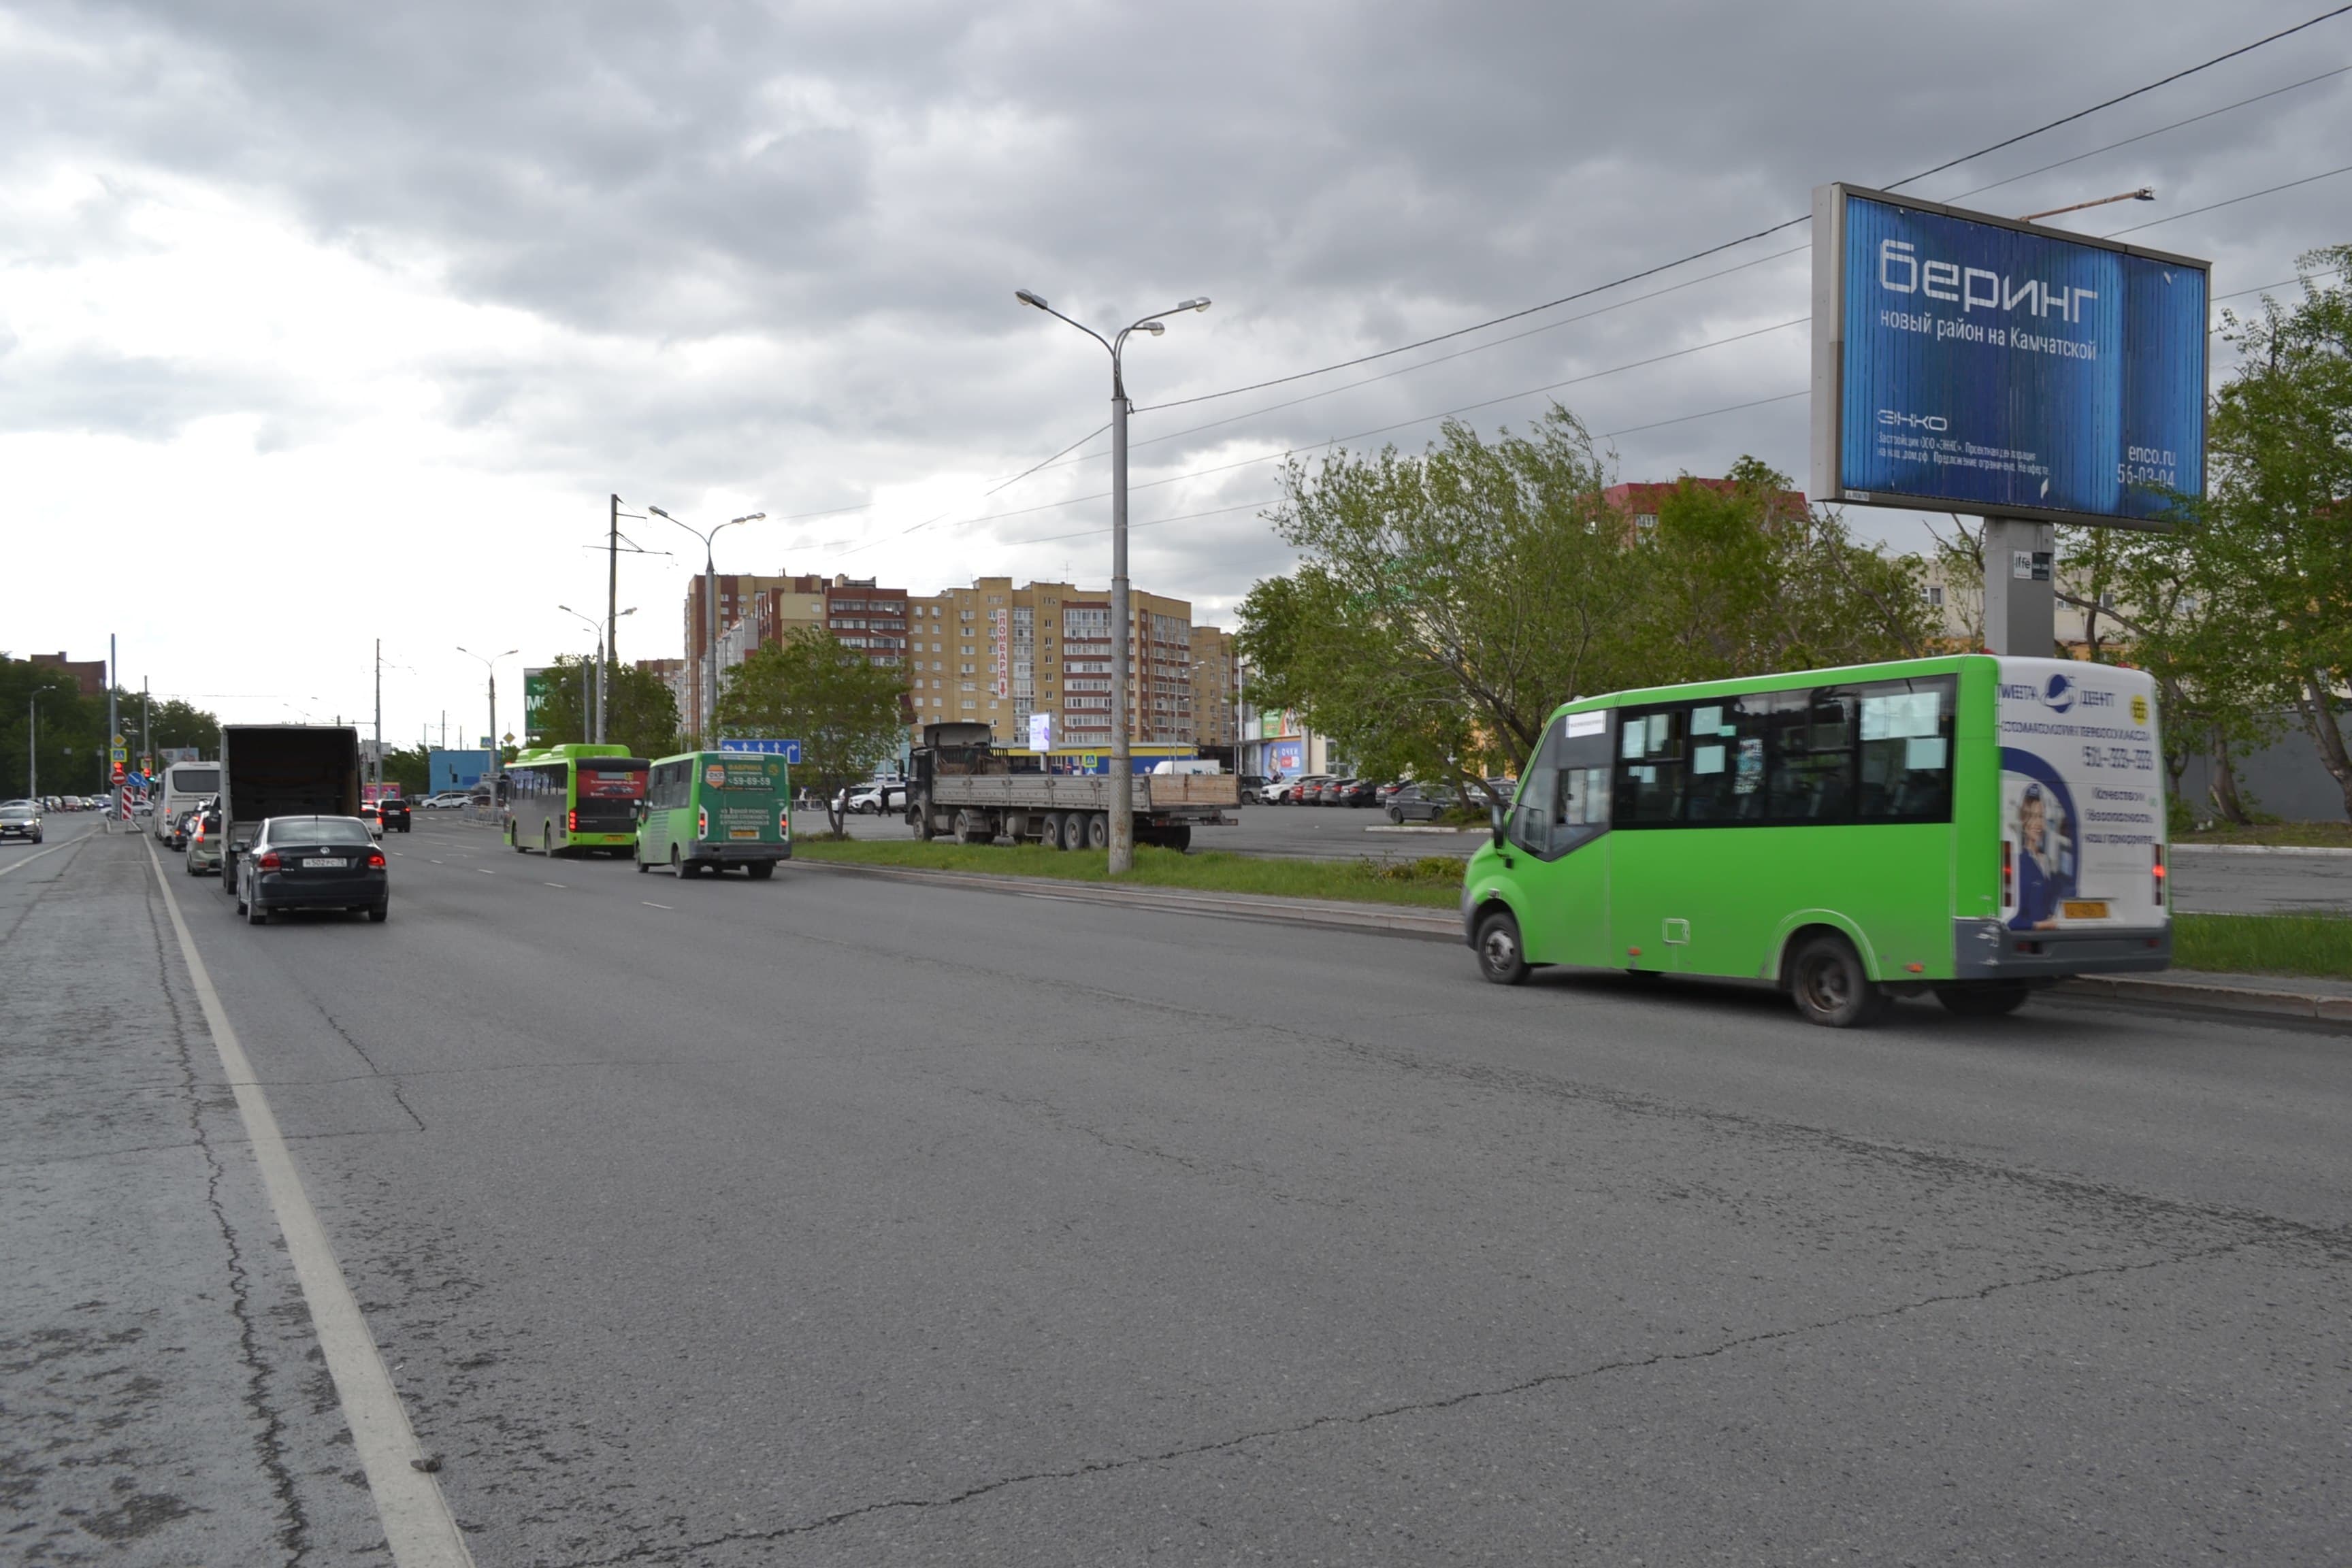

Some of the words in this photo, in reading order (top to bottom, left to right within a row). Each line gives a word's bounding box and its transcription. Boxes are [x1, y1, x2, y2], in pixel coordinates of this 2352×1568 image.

[1880, 309, 1931, 334] новый
[1937, 317, 1984, 342] район
[1988, 327, 2006, 346] на
[2010, 327, 2097, 361] Камчатской
[2117, 463, 2176, 488] 56-03-04
[2128, 446, 2176, 467] enco.ru
[998, 617, 1007, 679] ЛОМБАРД
